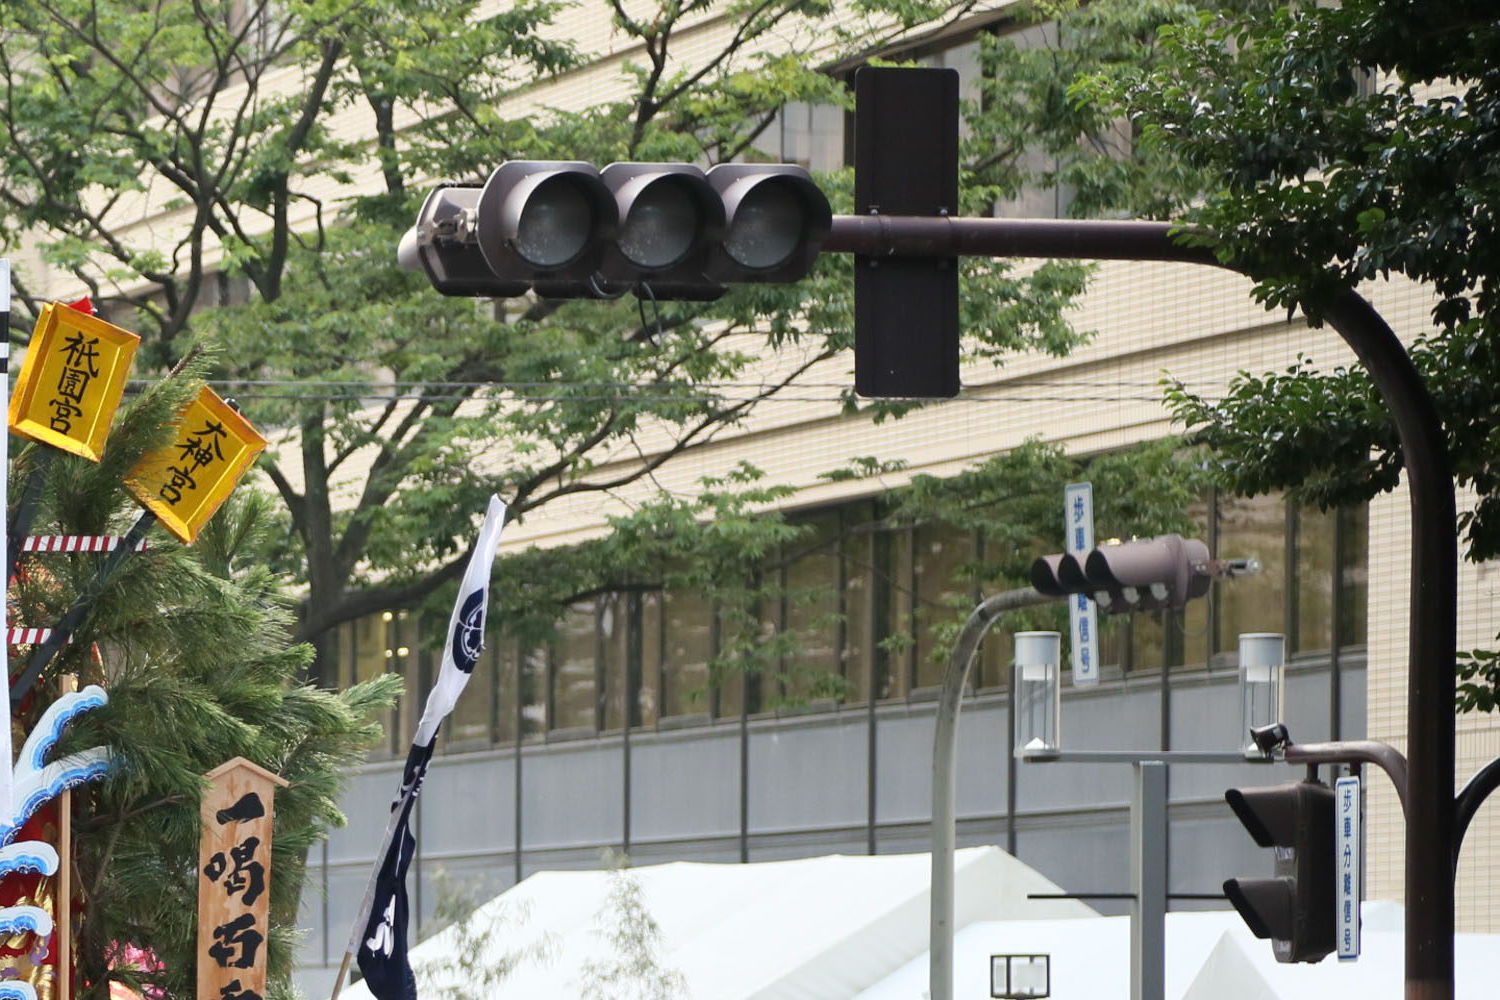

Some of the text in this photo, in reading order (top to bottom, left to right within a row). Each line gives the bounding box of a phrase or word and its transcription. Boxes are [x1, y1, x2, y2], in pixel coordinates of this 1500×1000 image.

[49, 331, 100, 436] 祇園宮
[160, 419, 228, 506] 大神宮
[1343, 788, 1352, 951] 歩車分離信号
